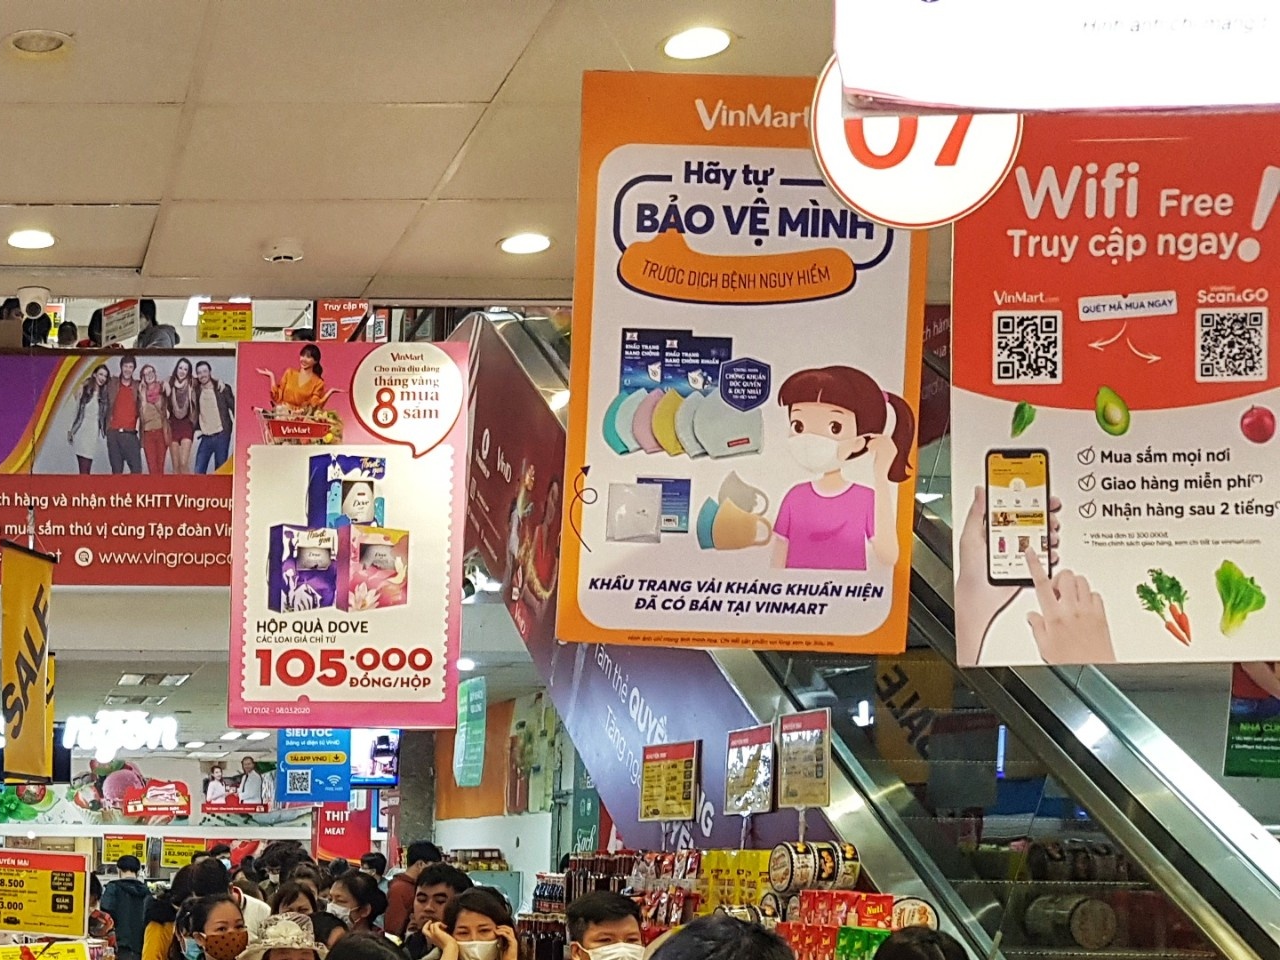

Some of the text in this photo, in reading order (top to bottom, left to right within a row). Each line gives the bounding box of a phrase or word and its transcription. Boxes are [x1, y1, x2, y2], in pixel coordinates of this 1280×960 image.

[695, 98, 810, 130] VinMart
[684, 160, 776, 194] Hãy tự
[1015, 162, 1234, 220] Wifi Free
[636, 194, 874, 247] BẢO VỆ MÌNH
[1006, 226, 1240, 265] Truy cập ngay
[688, 268, 718, 290] DỊCH
[722, 266, 756, 293] BỆNH
[760, 268, 793, 289] NGUY
[796, 263, 831, 287] HIỂM
[1082, 300, 1108, 314] QUÉT
[1125, 300, 1146, 311] MUA
[1148, 298, 1173, 310] NGAY
[1100, 446, 1230, 466] Mua sắm mọi nơi
[1101, 472, 1222, 492] Giao hàng miễn
[14, 493, 48, 510] hàng
[52, 494, 68, 508] và
[72, 494, 106, 510] nhận
[110, 493, 132, 508] thẻ
[136, 494, 171, 508] KHTT
[1102, 502, 1230, 520] Nhận hàng sau 2
[38, 521, 66, 536] sắm
[70, 523, 92, 536] thú
[96, 524, 108, 540] vị
[112, 524, 144, 540] cùng
[148, 522, 174, 540] Tập
[178, 522, 212, 538] đoàn
[588, 574, 885, 603] KHẨU TRANG VẢI KHÁNG KHUẨN HIỆN
[634, 597, 828, 616] ĐÃ CÓ BÁN TẠI VINMART
[256, 618, 369, 636] HỘP QUÀ DOVE
[324, 810, 350, 824] THỊT
[324, 827, 345, 836] MEAT
